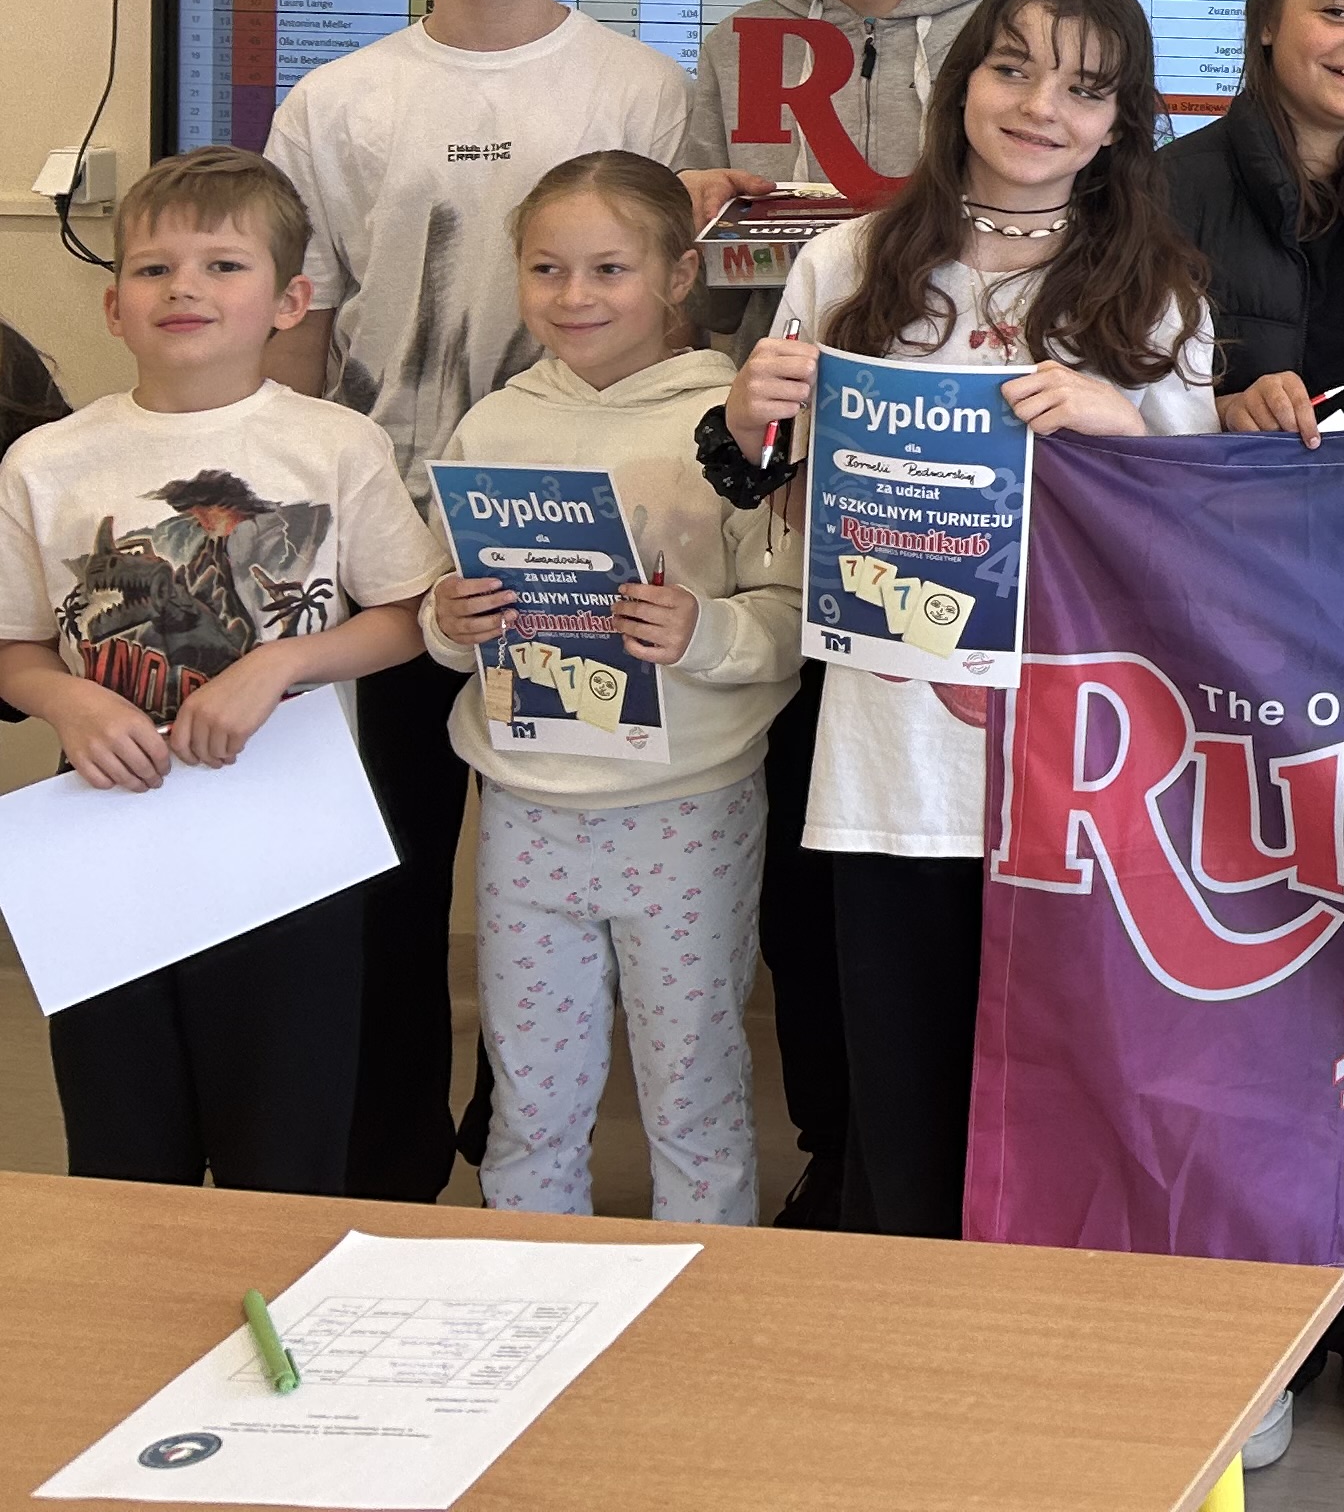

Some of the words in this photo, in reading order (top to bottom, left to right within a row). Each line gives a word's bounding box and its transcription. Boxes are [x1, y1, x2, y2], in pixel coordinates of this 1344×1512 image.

[841, 385, 992, 435] Dyplom
[904, 442, 922, 454] dla
[466, 491, 596, 529] Dyplom
[822, 491, 836, 507] W
[838, 496, 922, 523] SZKOLNYM
[926, 509, 1013, 529] TURNIEJU
[876, 481, 893, 494] za
[896, 483, 941, 501] udział
[841, 515, 990, 558] Rummikub
[524, 573, 538, 584] za
[540, 574, 577, 584] udział
[1201, 687, 1287, 729] The
